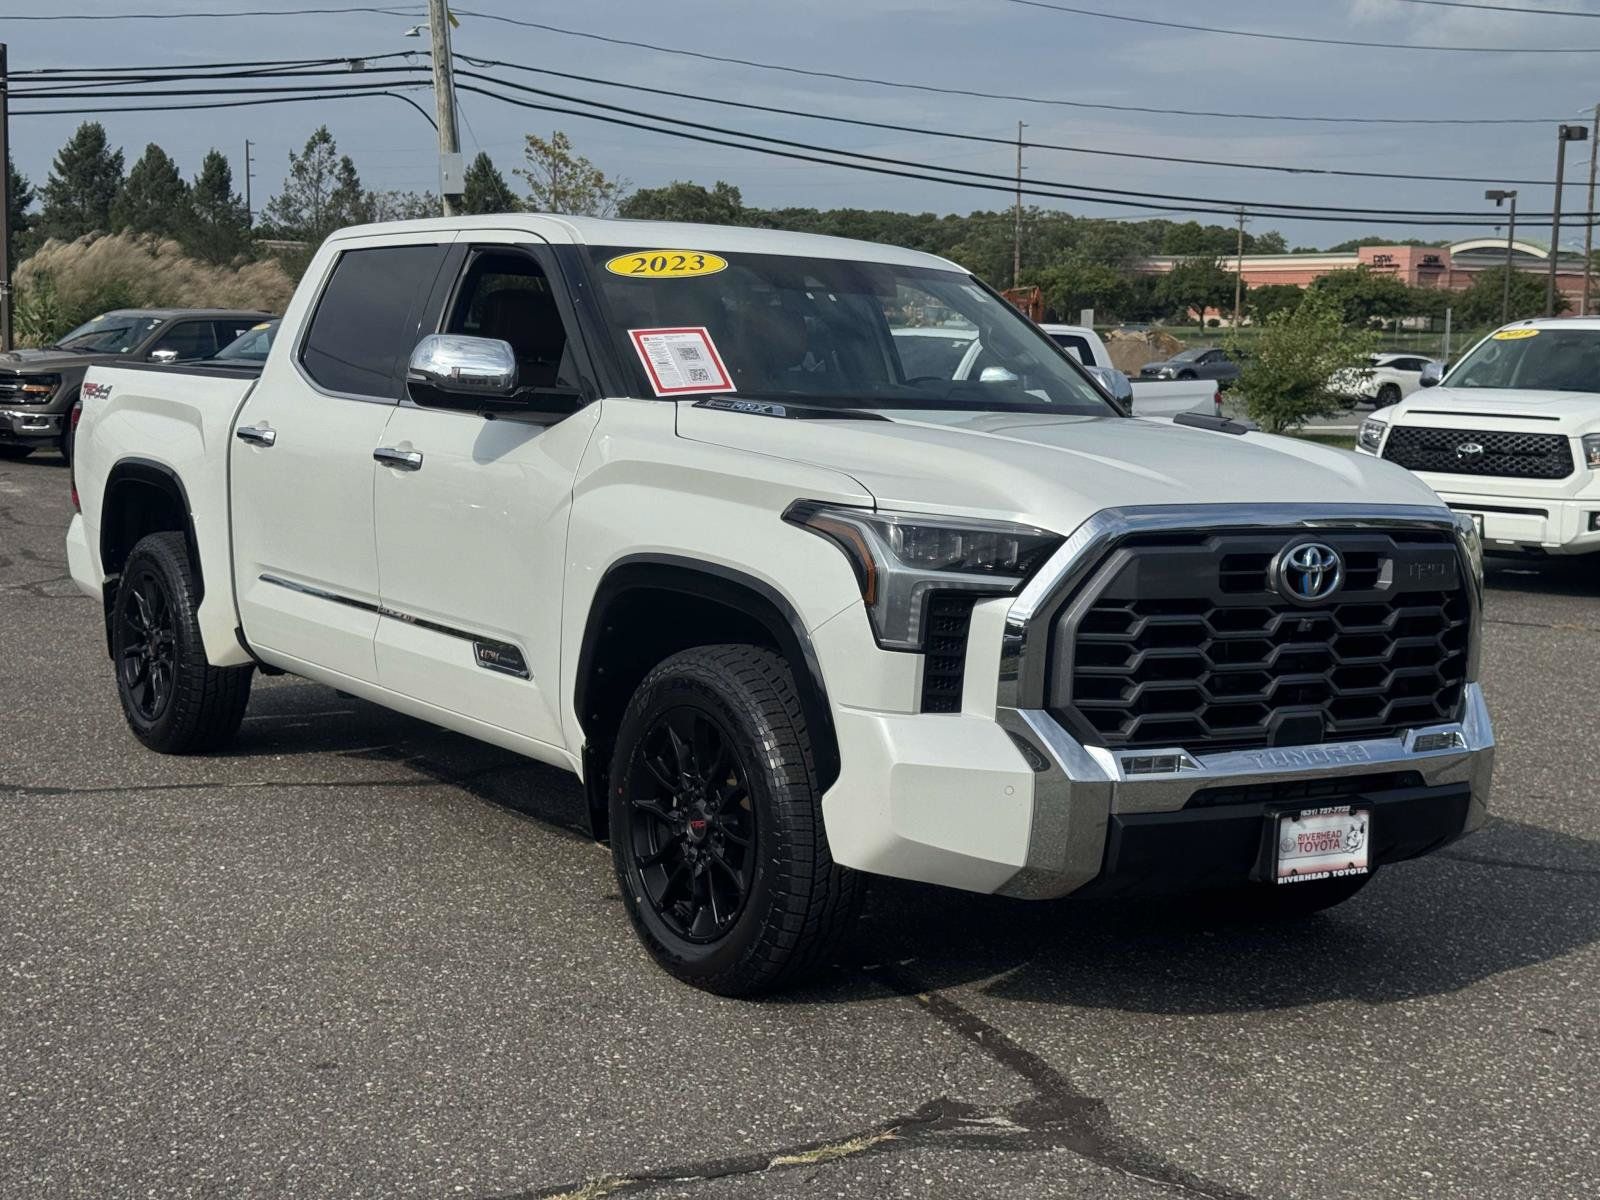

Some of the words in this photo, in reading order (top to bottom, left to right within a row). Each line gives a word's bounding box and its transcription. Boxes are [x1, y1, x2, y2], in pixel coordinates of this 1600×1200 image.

[630, 254, 705, 274] 2023
[1244, 745, 1371, 769] TUNDRA
[1297, 829, 1342, 841] RIVERHEAD
[1298, 838, 1340, 853] TOYOTA
[1278, 871, 1330, 885] RIVERHEAD
[1332, 866, 1368, 878] TOYOTA
